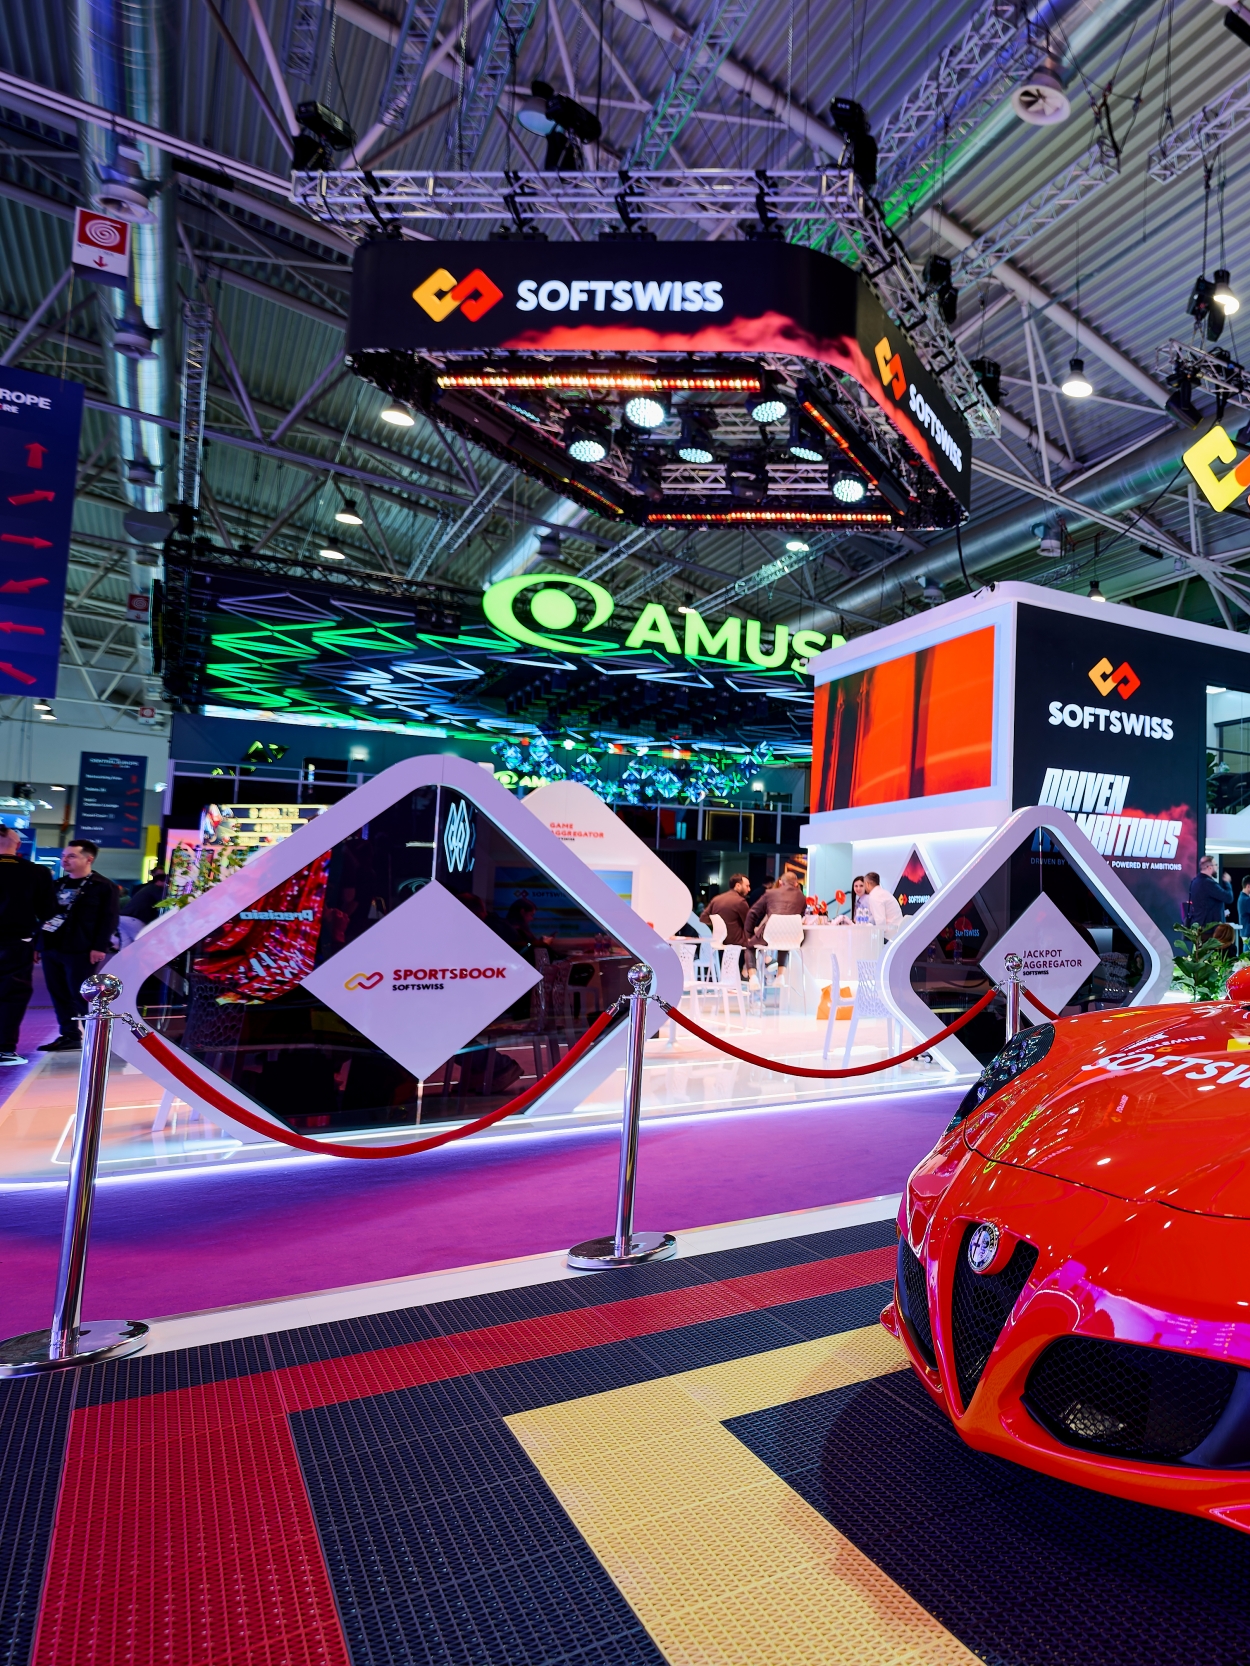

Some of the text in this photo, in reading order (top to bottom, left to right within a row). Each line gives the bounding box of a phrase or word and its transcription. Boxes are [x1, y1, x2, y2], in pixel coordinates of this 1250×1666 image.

[516, 280, 724, 313] SOFTSWISS
[909, 383, 963, 473] SOFTSWISS
[625, 603, 849, 674] AMUS
[1048, 701, 1174, 741] SOFTSWISS
[1038, 767, 1131, 815] DRIVEN
[550, 822, 573, 830] GAME
[1112, 861, 1141, 870] POWERED
[1142, 862, 1150, 870] BY
[1150, 862, 1182, 871] AMBITIONS
[1023, 949, 1062, 959] JACKPOT
[1023, 959, 1082, 970] AGGREGATOR
[392, 967, 507, 981] SPORTSBOOK
[392, 983, 444, 991] SOFTSWISS
